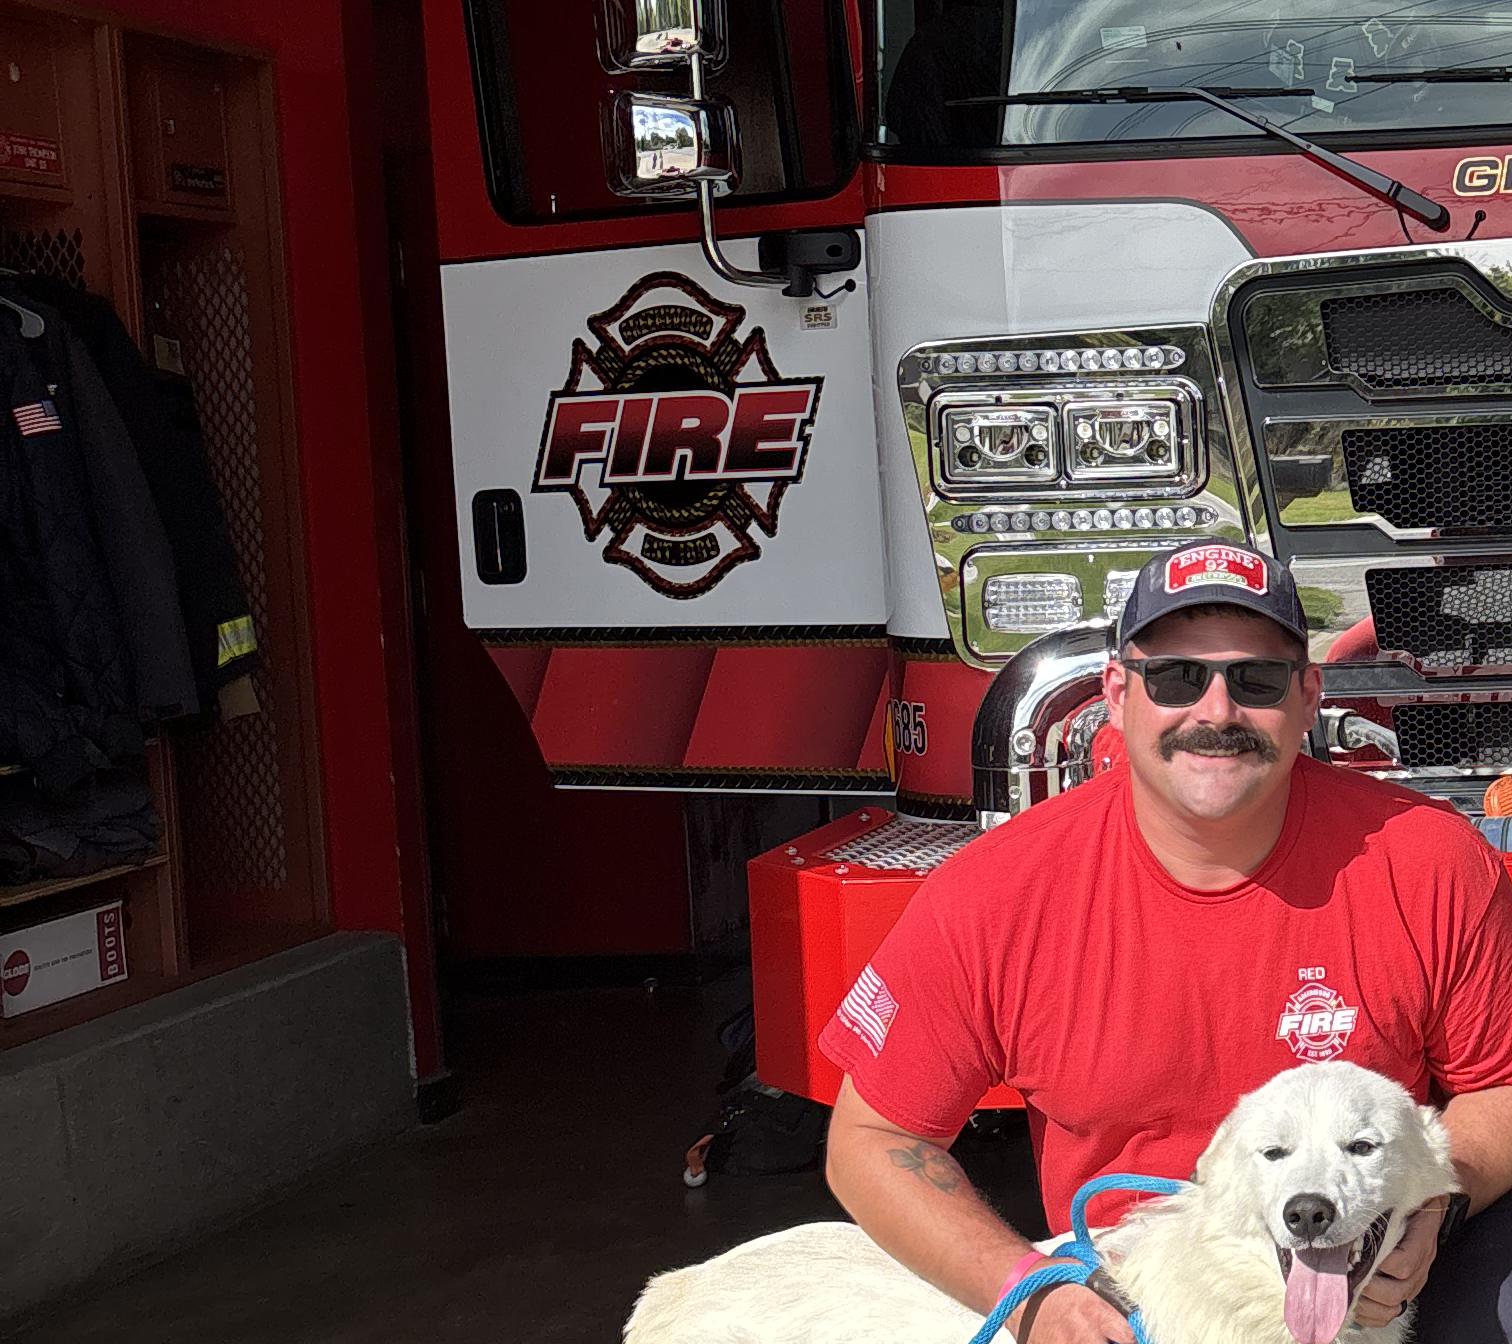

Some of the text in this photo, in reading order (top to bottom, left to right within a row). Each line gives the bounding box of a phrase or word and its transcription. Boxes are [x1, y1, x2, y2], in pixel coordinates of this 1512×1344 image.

[805, 313, 832, 323] SRS
[539, 384, 817, 485] FIRE
[1180, 549, 1254, 569] ENGINE
[1205, 560, 1229, 572] 92
[104, 913, 119, 975] BOOTS
[1298, 967, 1325, 980] RED
[1278, 1009, 1356, 1037] FIRE
